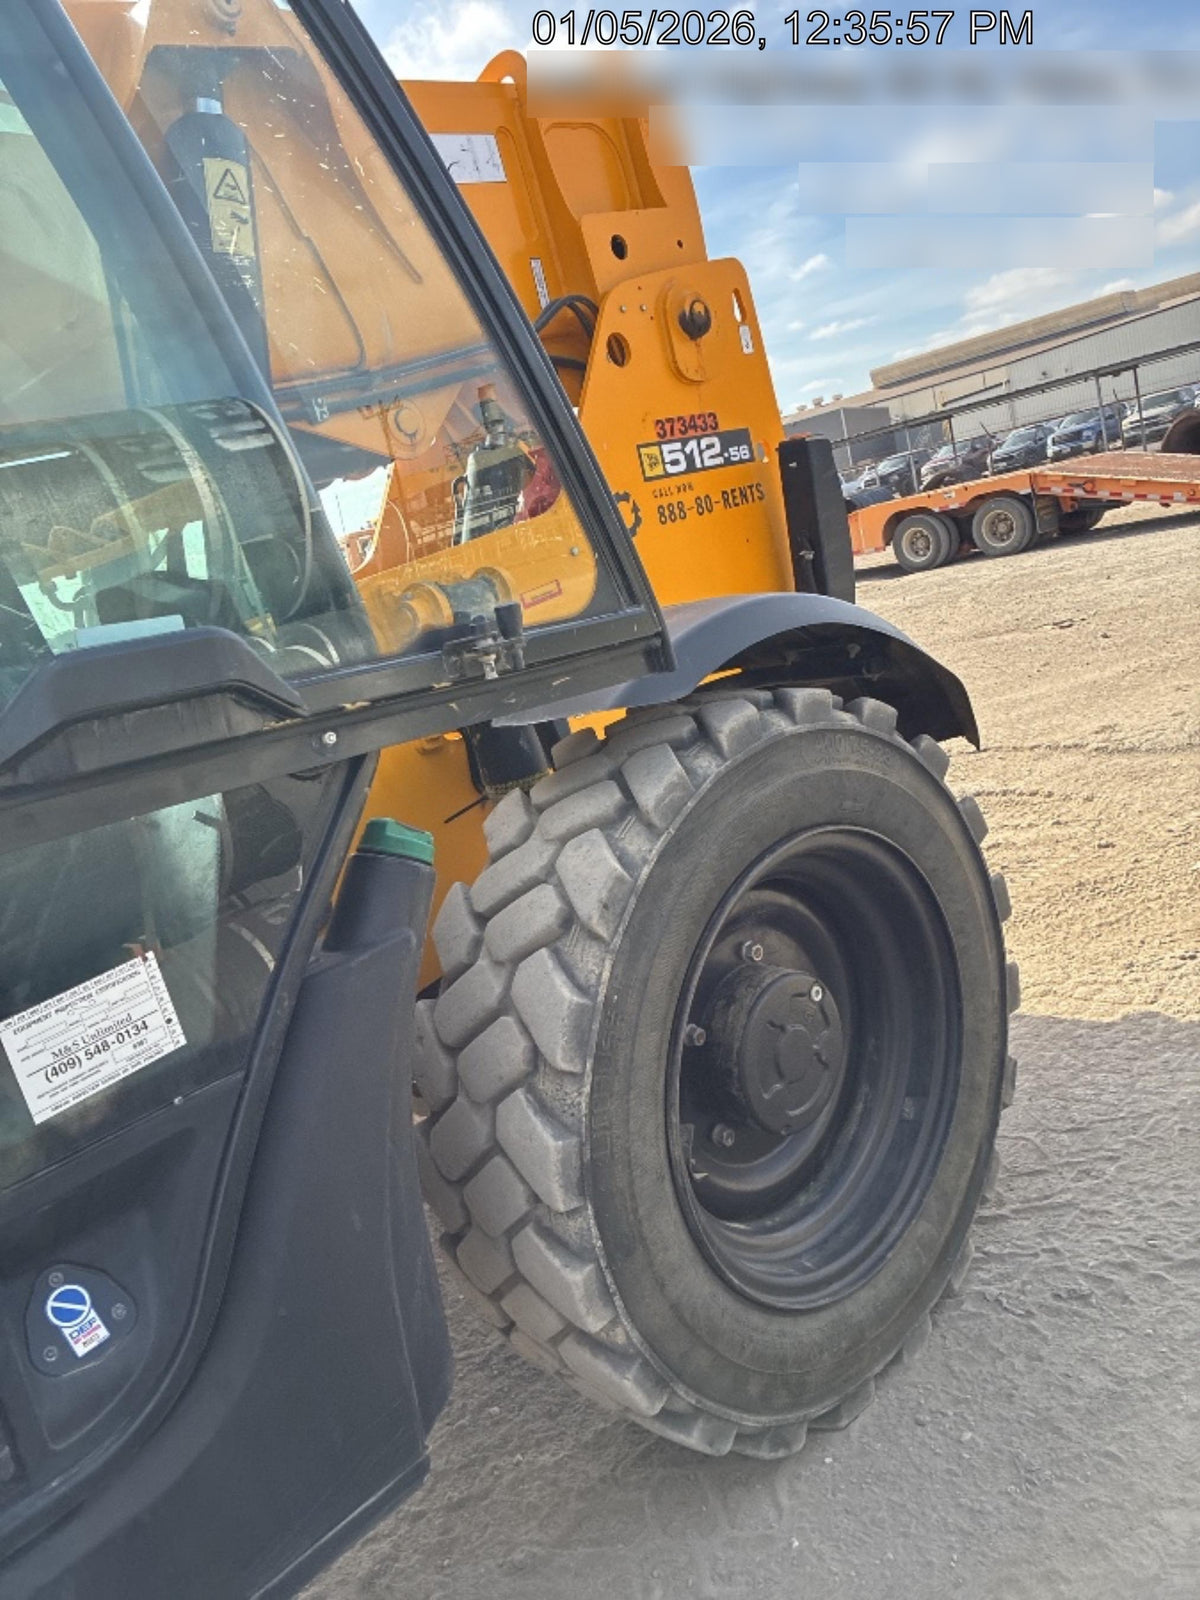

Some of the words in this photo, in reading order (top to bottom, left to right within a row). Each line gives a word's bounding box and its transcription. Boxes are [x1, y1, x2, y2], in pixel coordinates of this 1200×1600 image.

[655, 412, 719, 440] 373433
[657, 483, 766, 526] 888-80-RENTS
[45, 1054, 83, 1084] (409)
[85, 1020, 149, 1062] 548-0134
[51, 1040, 80, 1060] M&S
[81, 1013, 133, 1043] Unlimited
